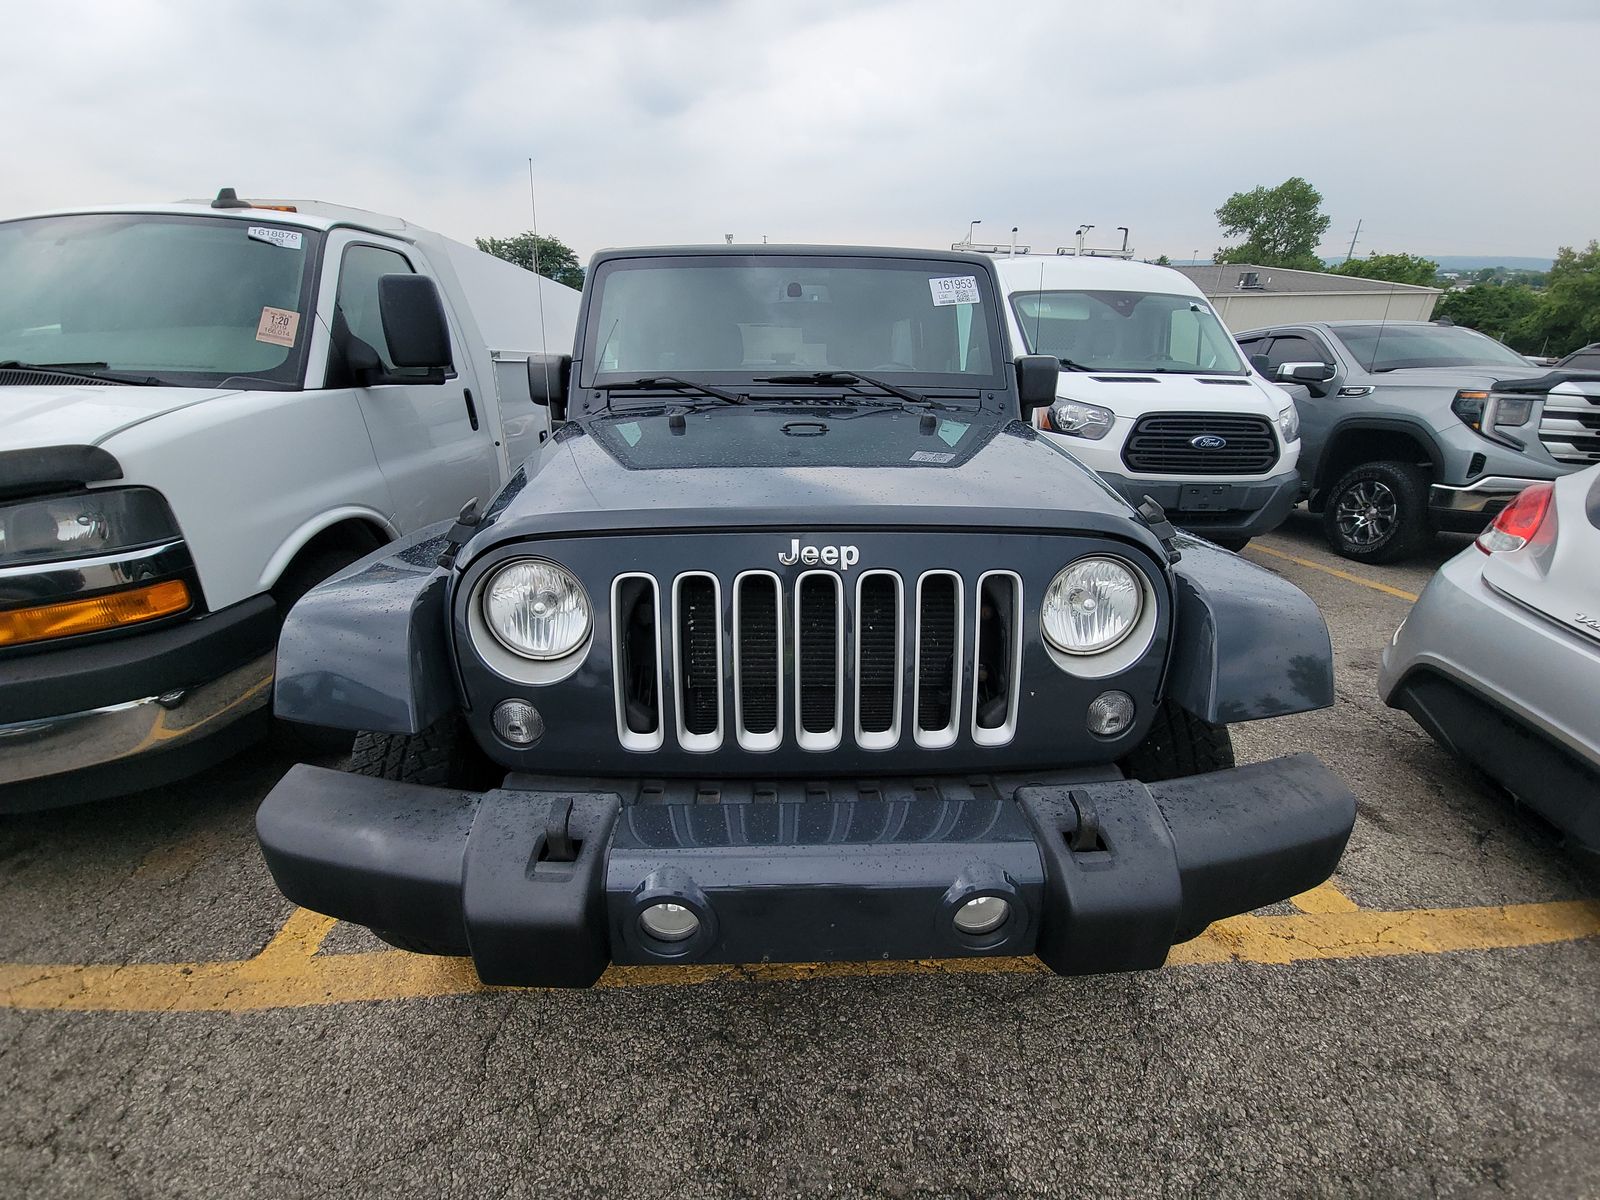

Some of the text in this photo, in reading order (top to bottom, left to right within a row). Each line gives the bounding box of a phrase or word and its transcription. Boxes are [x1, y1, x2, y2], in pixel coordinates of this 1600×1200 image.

[252, 229, 298, 241] 1618876
[271, 315, 289, 326] 1:20
[1200, 438, 1220, 447] Ford
[778, 539, 859, 570] Jeep
